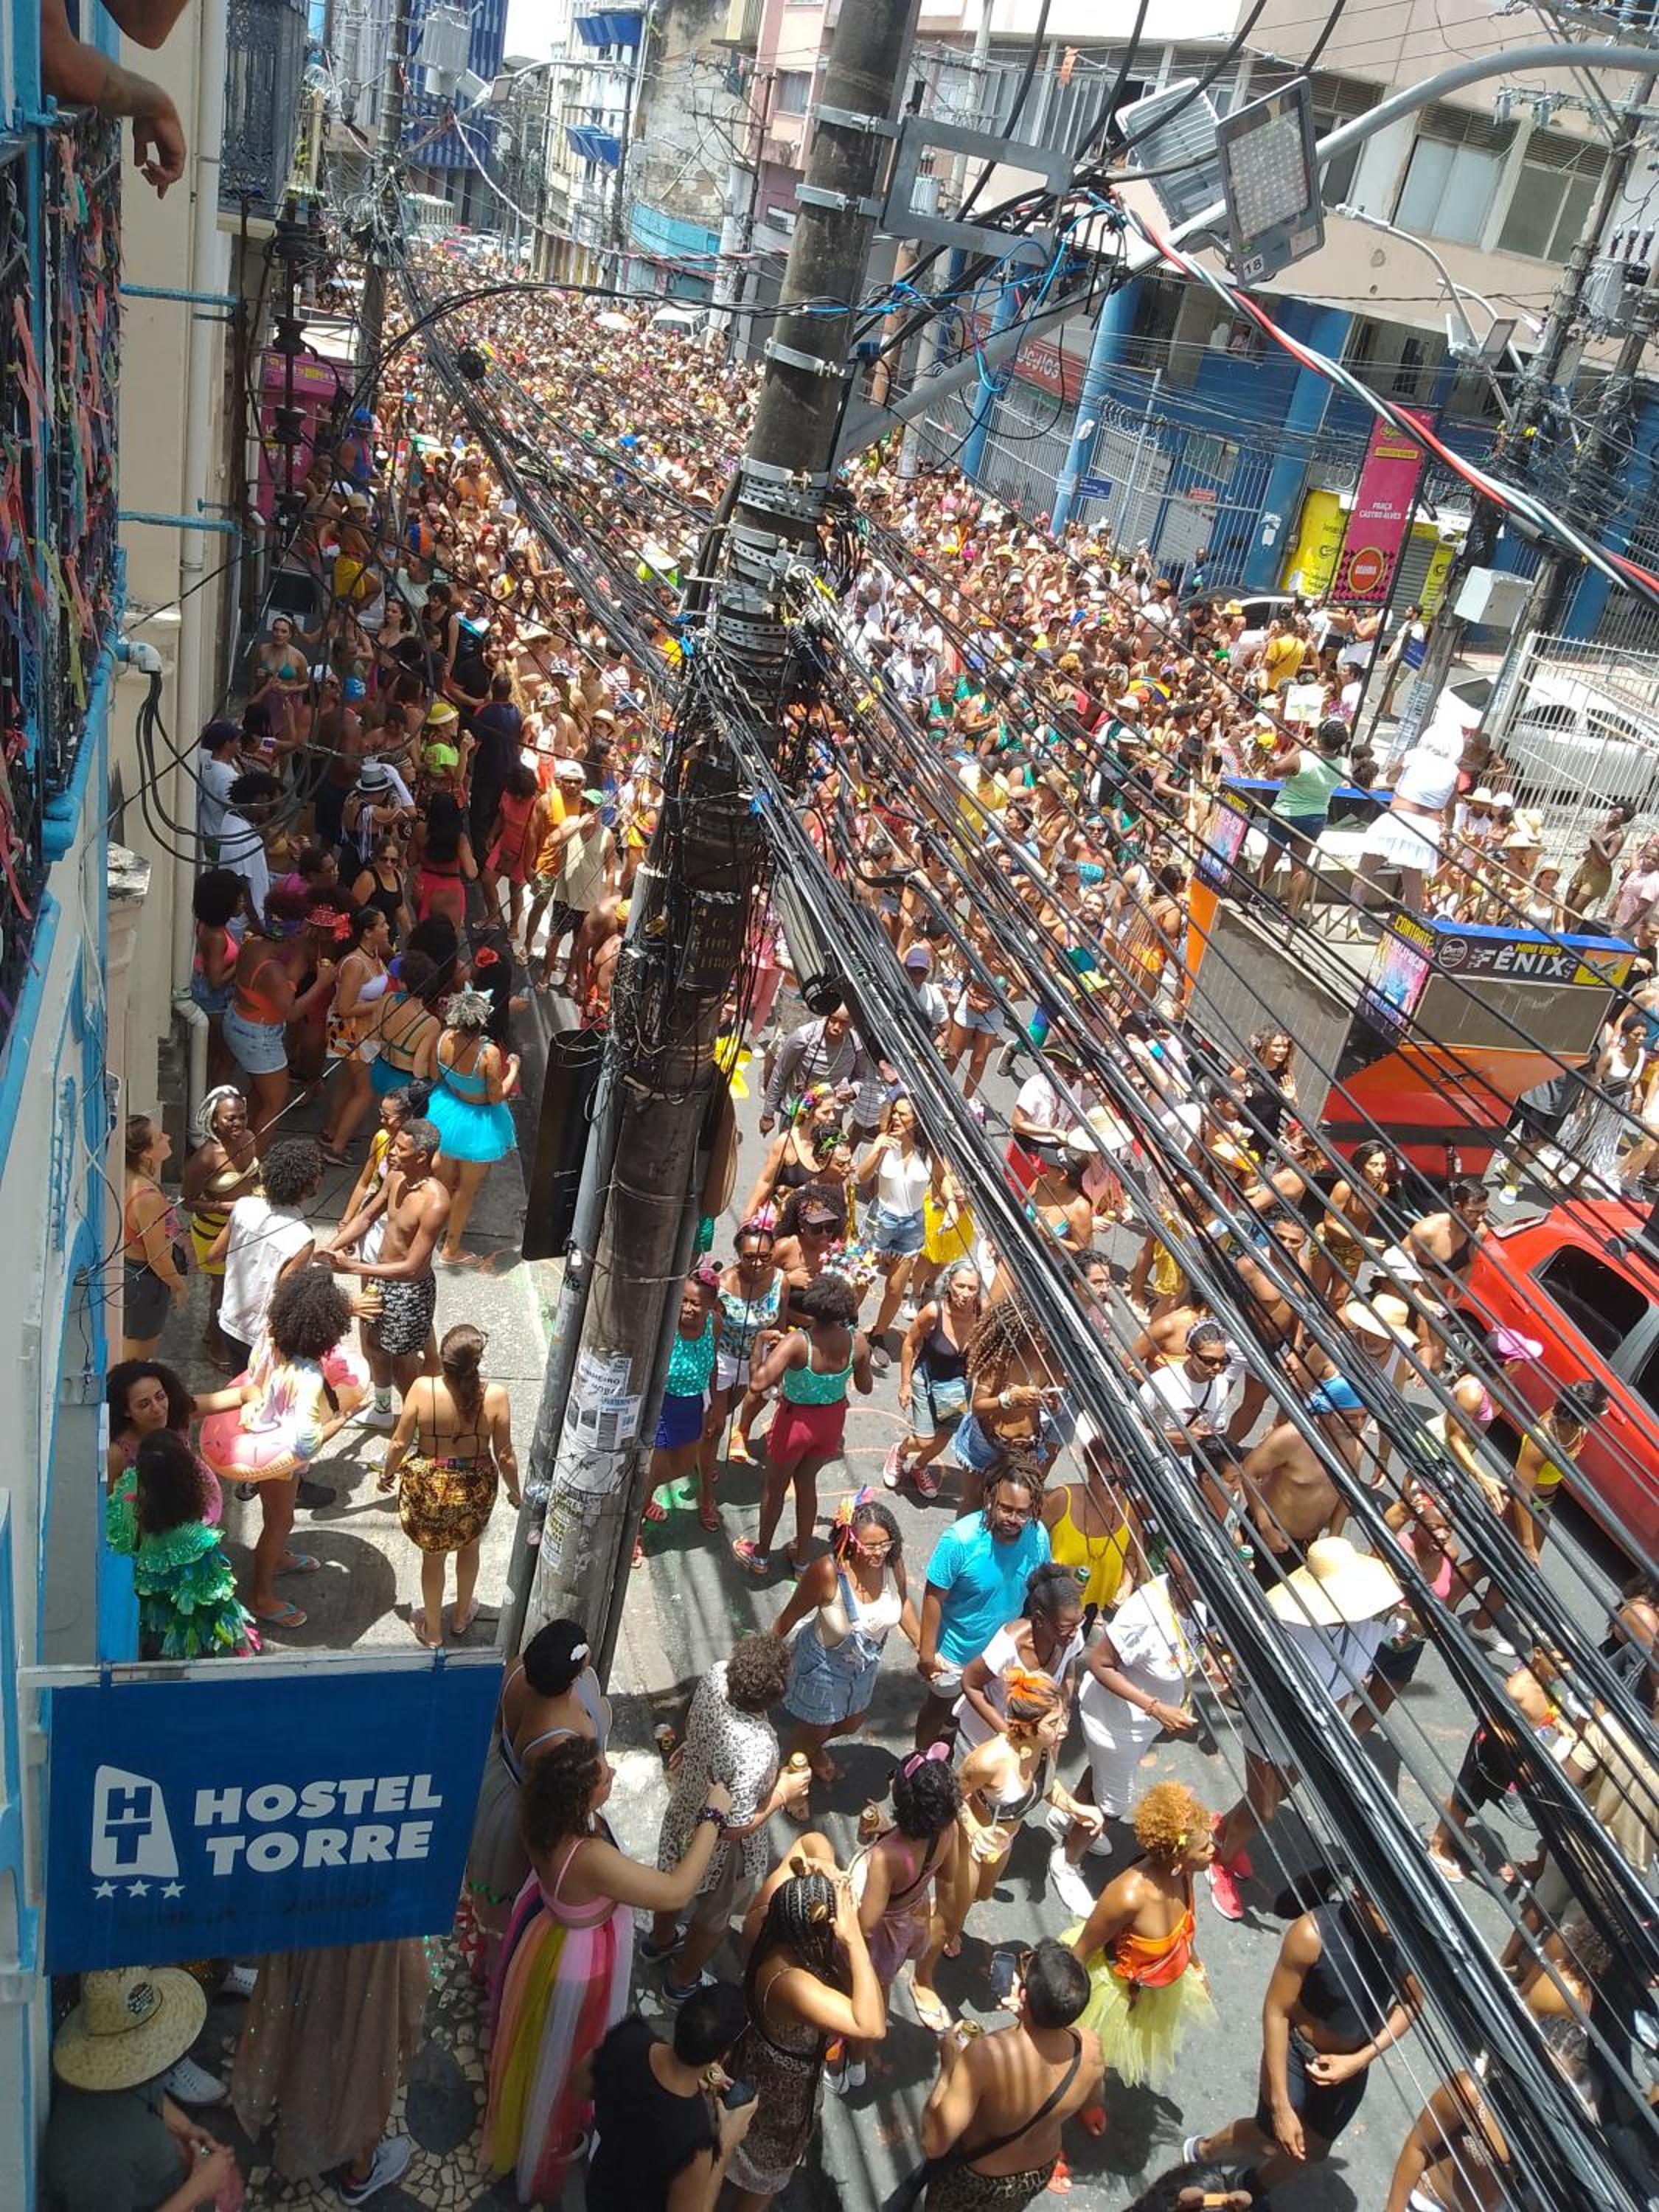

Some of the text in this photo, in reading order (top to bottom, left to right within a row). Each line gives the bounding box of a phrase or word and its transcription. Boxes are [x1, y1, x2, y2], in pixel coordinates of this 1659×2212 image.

[1244, 259, 1262, 274] 18
[1469, 945, 1570, 978] FÊNIX
[194, 1773, 442, 1826] HOSTEL
[205, 1820, 434, 1876] TORRE
